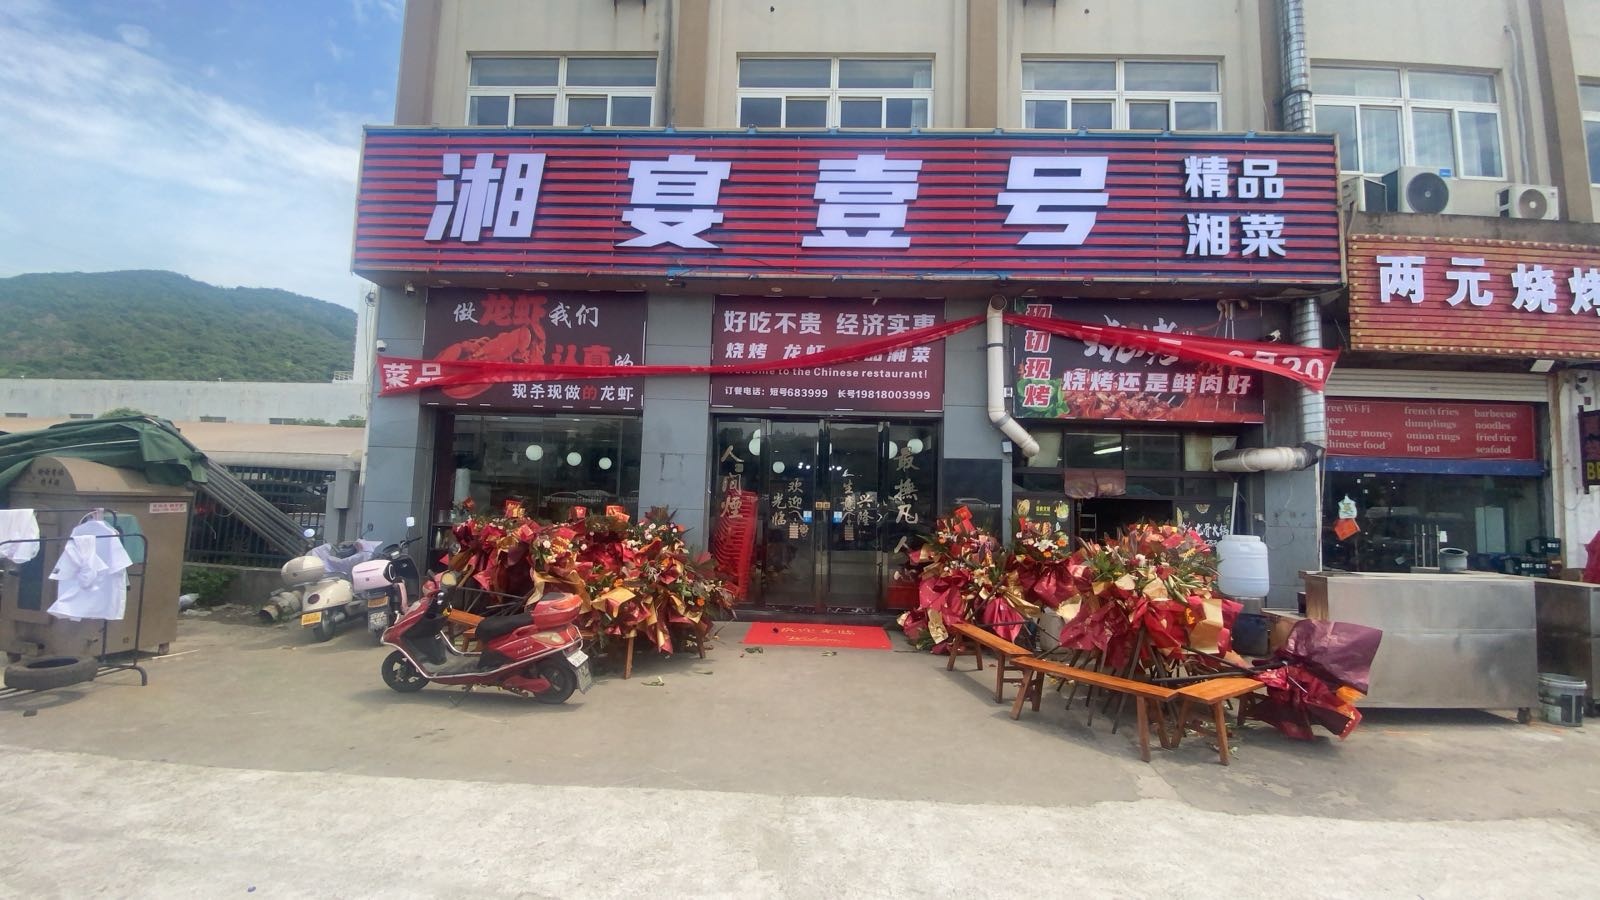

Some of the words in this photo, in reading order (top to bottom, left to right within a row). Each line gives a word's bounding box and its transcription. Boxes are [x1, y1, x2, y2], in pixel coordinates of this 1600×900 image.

[1184, 154, 1284, 199] 精品
[424, 152, 1109, 249] 湘宴壹号
[1186, 213, 1287, 258] 湘菜
[723, 310, 822, 335] 好吃不贵
[725, 342, 768, 360] 烧烤
[792, 367, 811, 376] the
[813, 367, 859, 378] Chinese
[861, 369, 928, 379] restaurant!
[1062, 371, 1251, 396] 烧烤还是鲜肉好
[512, 383, 634, 403] 现杀现做的龙虾
[1326, 404, 1343, 413] ree
[1404, 406, 1436, 416] french
[1437, 407, 1460, 417] fries
[1474, 408, 1518, 418] barbecue
[1404, 418, 1457, 430] dumplings
[1475, 421, 1512, 431] noodles
[1326, 427, 1359, 439] hange
[1360, 430, 1394, 441] money
[1406, 432, 1435, 441] onion
[1436, 432, 1461, 443] rings
[1476, 432, 1499, 442] fried
[1499, 433, 1518, 442] rice
[1363, 440, 1386, 450] food
[1406, 443, 1423, 453] hot
[1424, 444, 1441, 455] pot
[1475, 444, 1512, 454] seafood
[787, 478, 804, 510] 欢迎
[771, 492, 787, 527] 光临
